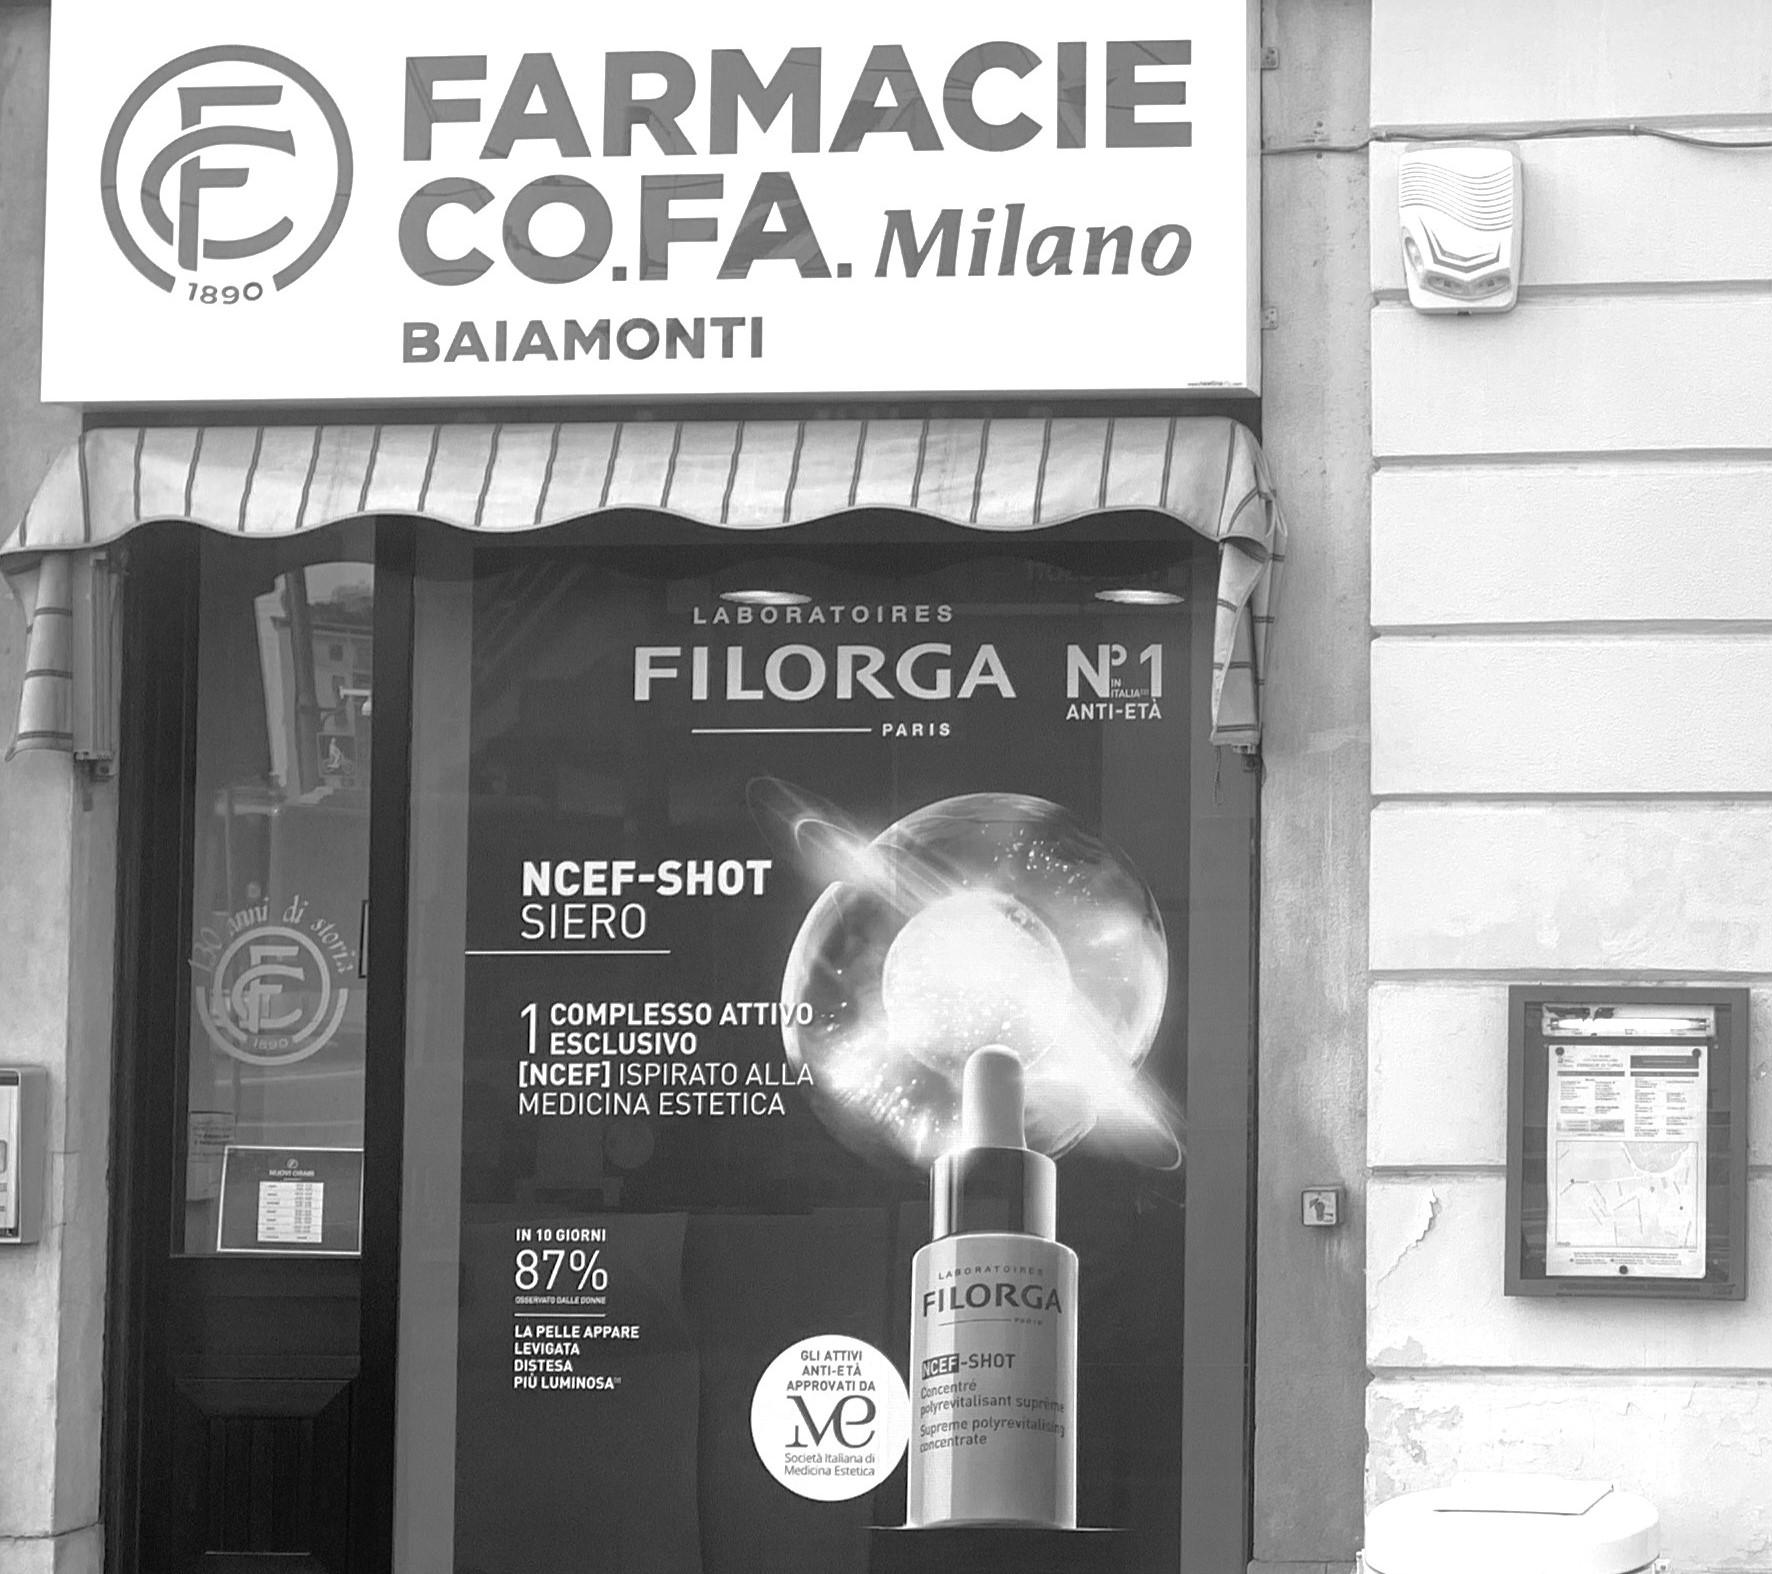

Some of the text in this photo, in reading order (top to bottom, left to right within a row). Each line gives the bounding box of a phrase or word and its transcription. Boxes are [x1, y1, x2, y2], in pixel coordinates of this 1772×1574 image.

[402, 40, 1193, 162] FARMACIE
[398, 171, 1193, 286] CO.FA. Milano
[187, 279, 264, 306] 1890
[402, 317, 764, 364] BAIAMONTI
[692, 605, 954, 624] LABORATOIRES
[634, 643, 1017, 701] FILORGA
[1066, 698, 1162, 720] ANTI-ETÀ
[882, 723, 951, 737] PARIS
[522, 859, 773, 897] NCEF-SHOT
[282, 894, 309, 924] di
[520, 902, 646, 940] SIERO
[520, 1002, 813, 1054] 1 COMPLESSO ATTIVO
[550, 1032, 697, 1056] ESCLUSIVO
[619, 1063, 738, 1086] ISPIRATO
[745, 1063, 814, 1086] ALLA
[519, 1092, 785, 1116] MEDICINA ESTETICA
[515, 1228, 606, 1242] IN 10 GIORNI
[515, 1249, 608, 1290] 87%
[938, 1265, 1044, 1280] LABORATOIRES
[923, 1283, 1063, 1317] FILORGA
[514, 1325, 640, 1338] LA PELLE APPARE
[514, 1342, 580, 1355] LEVIGATA
[800, 1350, 862, 1361] GLI ATTIVI
[514, 1359, 573, 1372] DISTESA
[802, 1362, 862, 1376] ANTI-ETÀ
[922, 1353, 1016, 1380] NCEF-SHOT
[514, 1373, 615, 1389] PIÙ LUMINOSA
[786, 1380, 876, 1391] APPROVATI DA
[920, 1379, 977, 1399] Concentré
[920, 1434, 987, 1453] concentrate
[785, 1453, 875, 1463] Società Italiana di
[784, 1465, 876, 1476] Medicina Estetica
